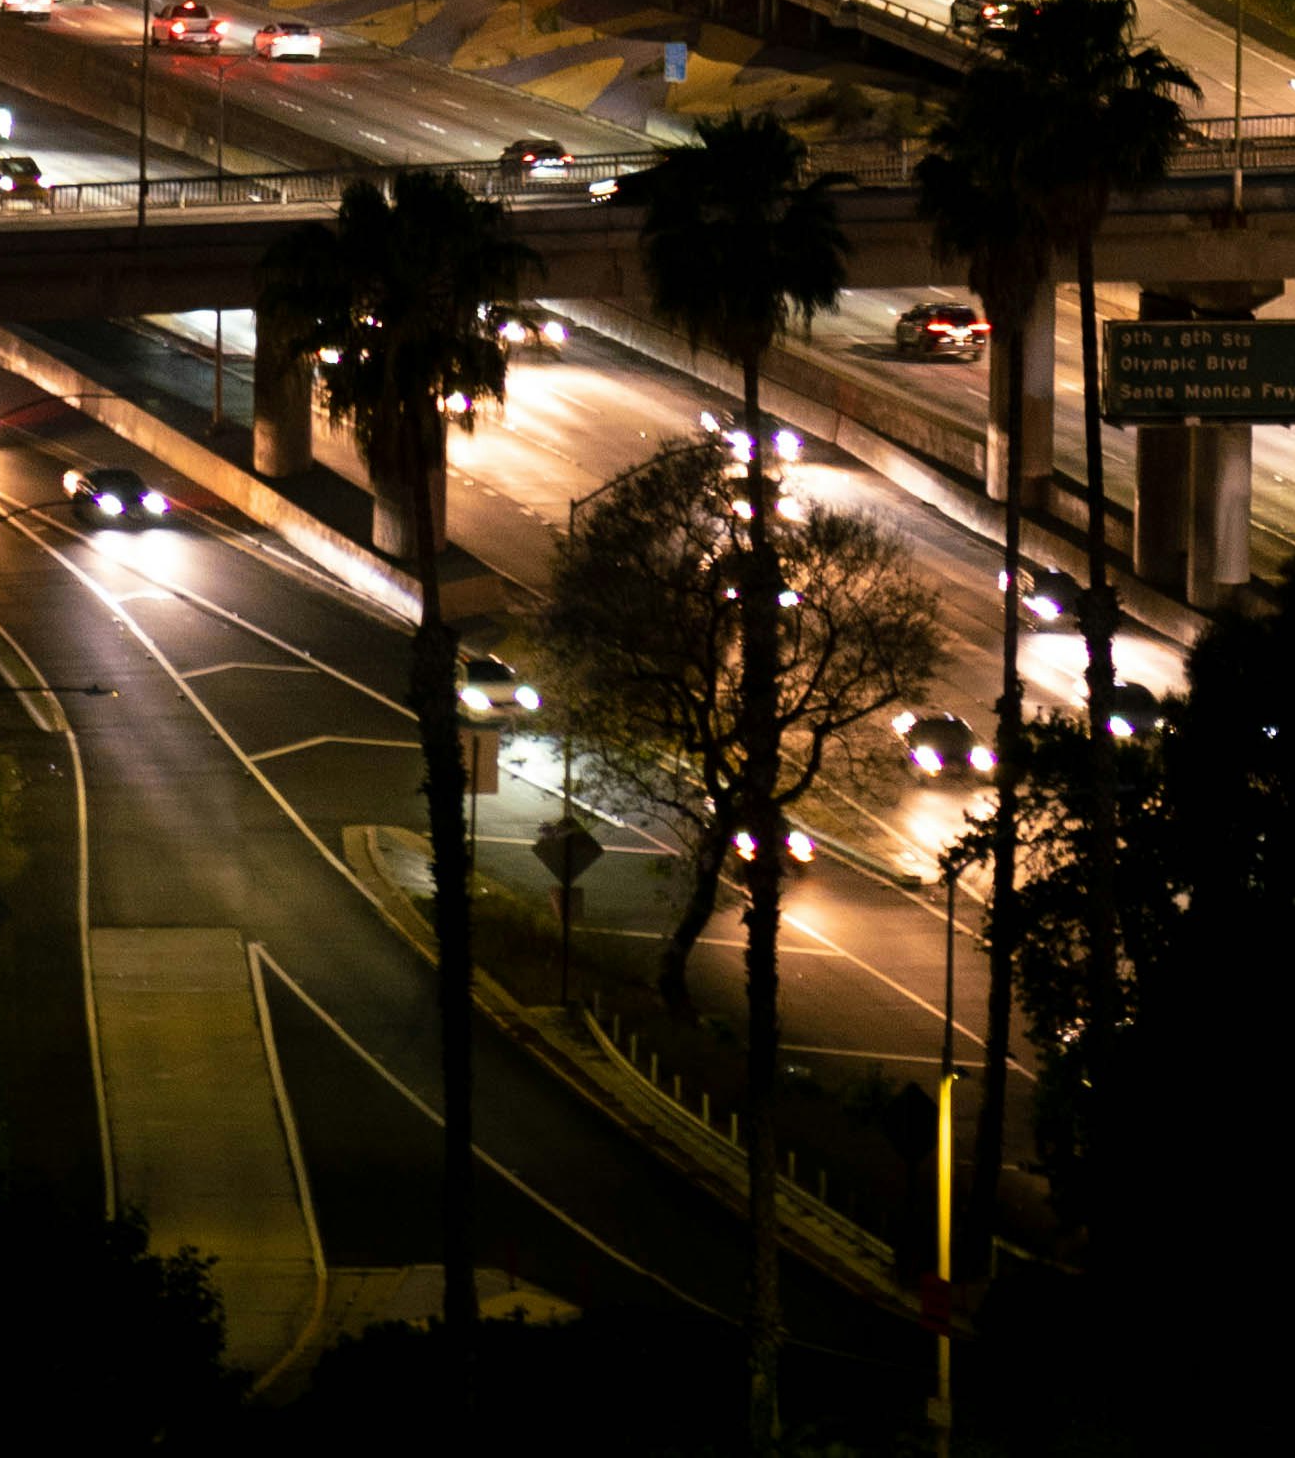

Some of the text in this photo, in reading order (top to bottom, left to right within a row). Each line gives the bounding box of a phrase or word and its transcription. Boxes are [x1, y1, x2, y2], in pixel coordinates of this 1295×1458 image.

[1120, 331, 1153, 348] 9th
[1220, 331, 1253, 348] Sts
[1120, 355, 1198, 373] Olympic
[1206, 352, 1249, 370] Blvd
[1119, 383, 1175, 400] Santa
[1184, 383, 1252, 399] Monica
